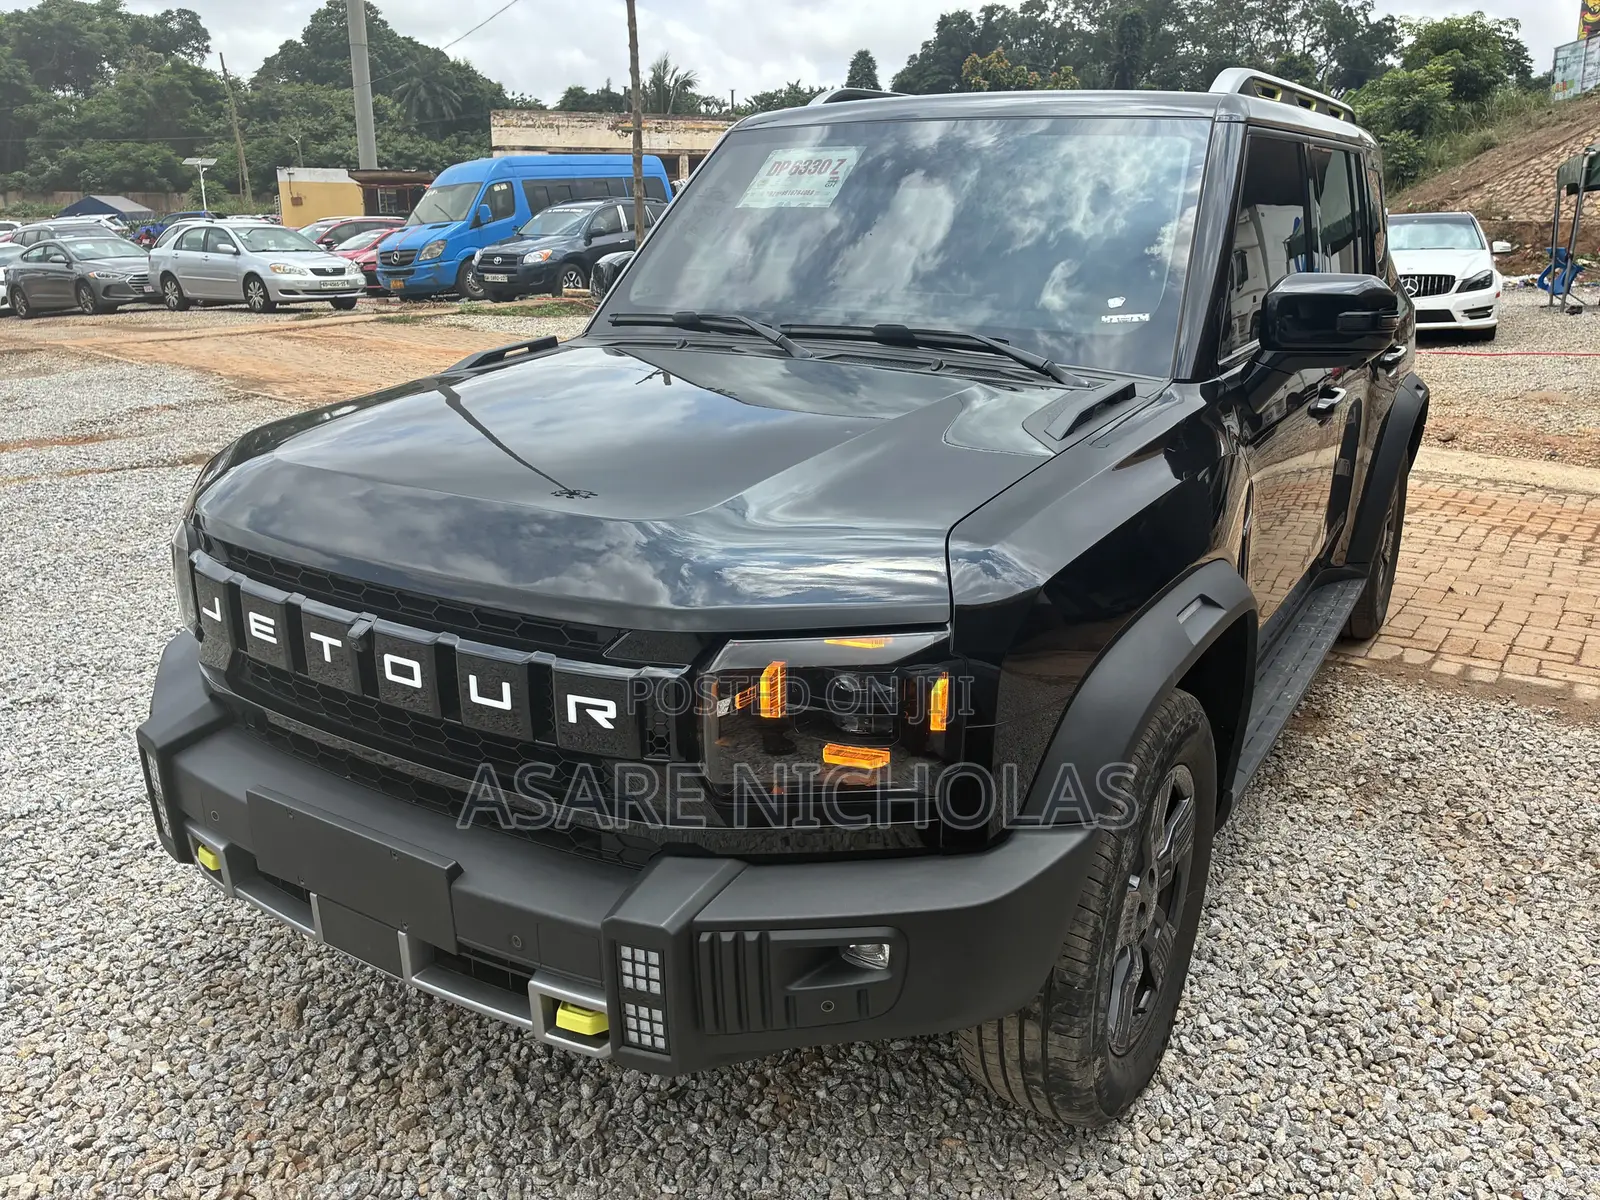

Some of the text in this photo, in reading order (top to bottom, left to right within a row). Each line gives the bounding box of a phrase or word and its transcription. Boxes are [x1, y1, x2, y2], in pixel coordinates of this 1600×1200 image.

[766, 158, 847, 177] DP 6330 Z
[202, 597, 617, 729] JETOUR
